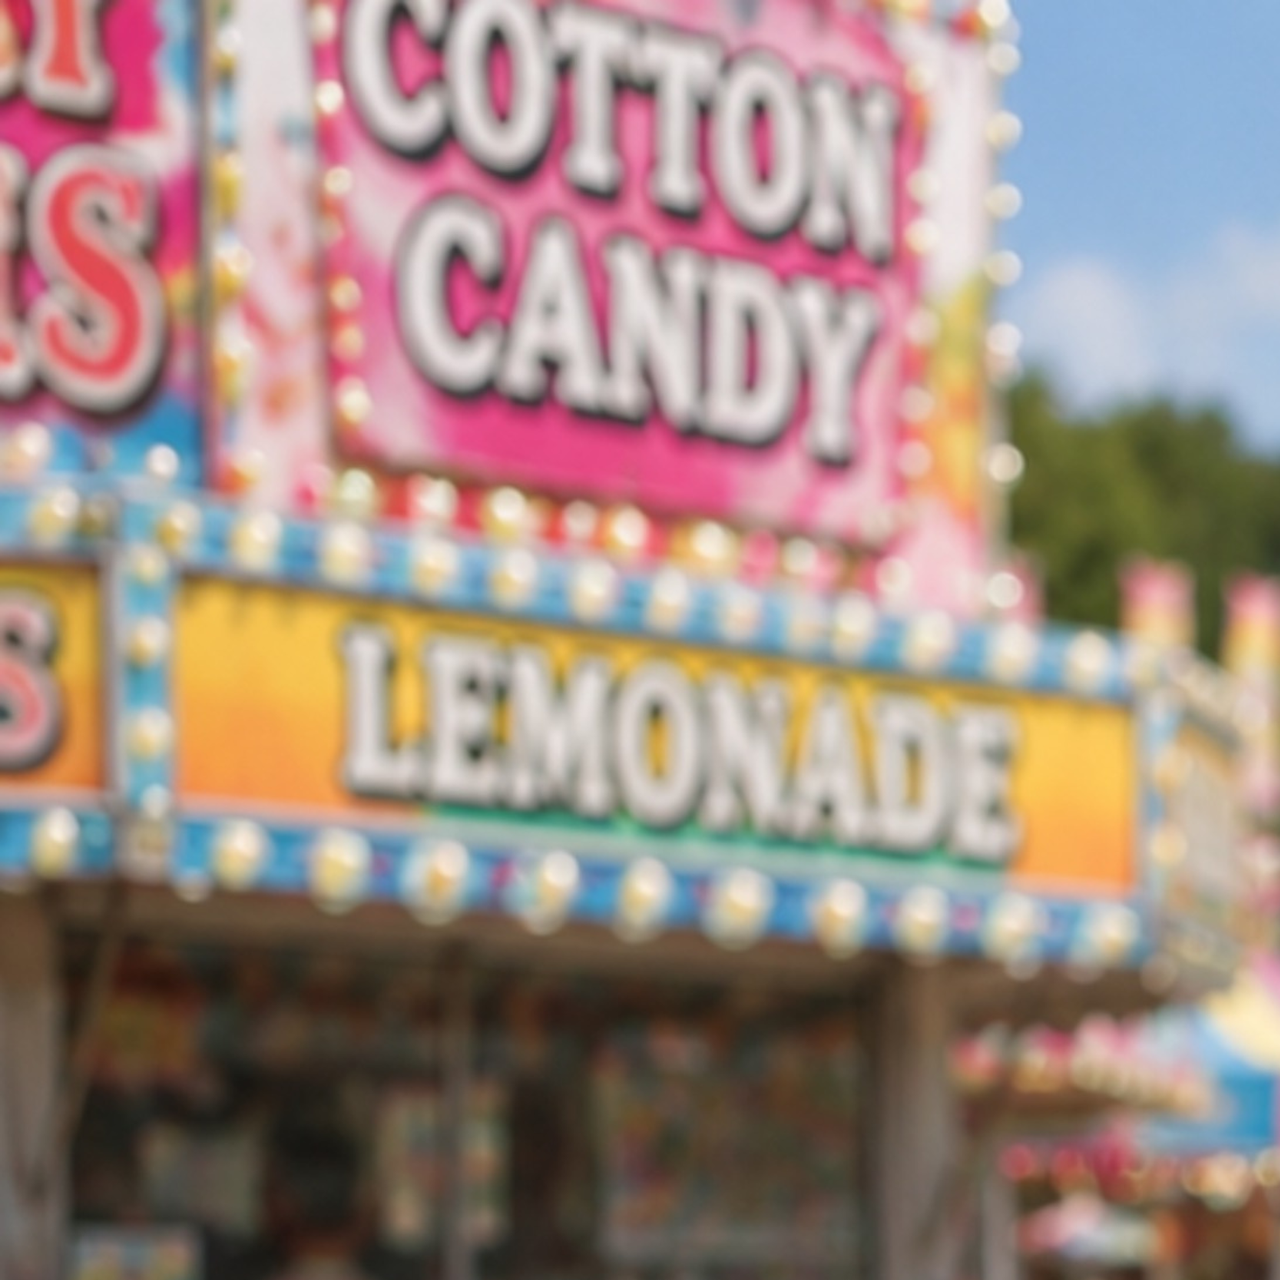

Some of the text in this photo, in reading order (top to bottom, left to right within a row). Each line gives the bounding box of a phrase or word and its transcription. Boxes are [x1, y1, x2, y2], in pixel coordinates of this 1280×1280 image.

[342, 0, 902, 265] COTTON
[399, 194, 879, 466] CANDY
[341, 620, 1022, 861] LEMONADE
